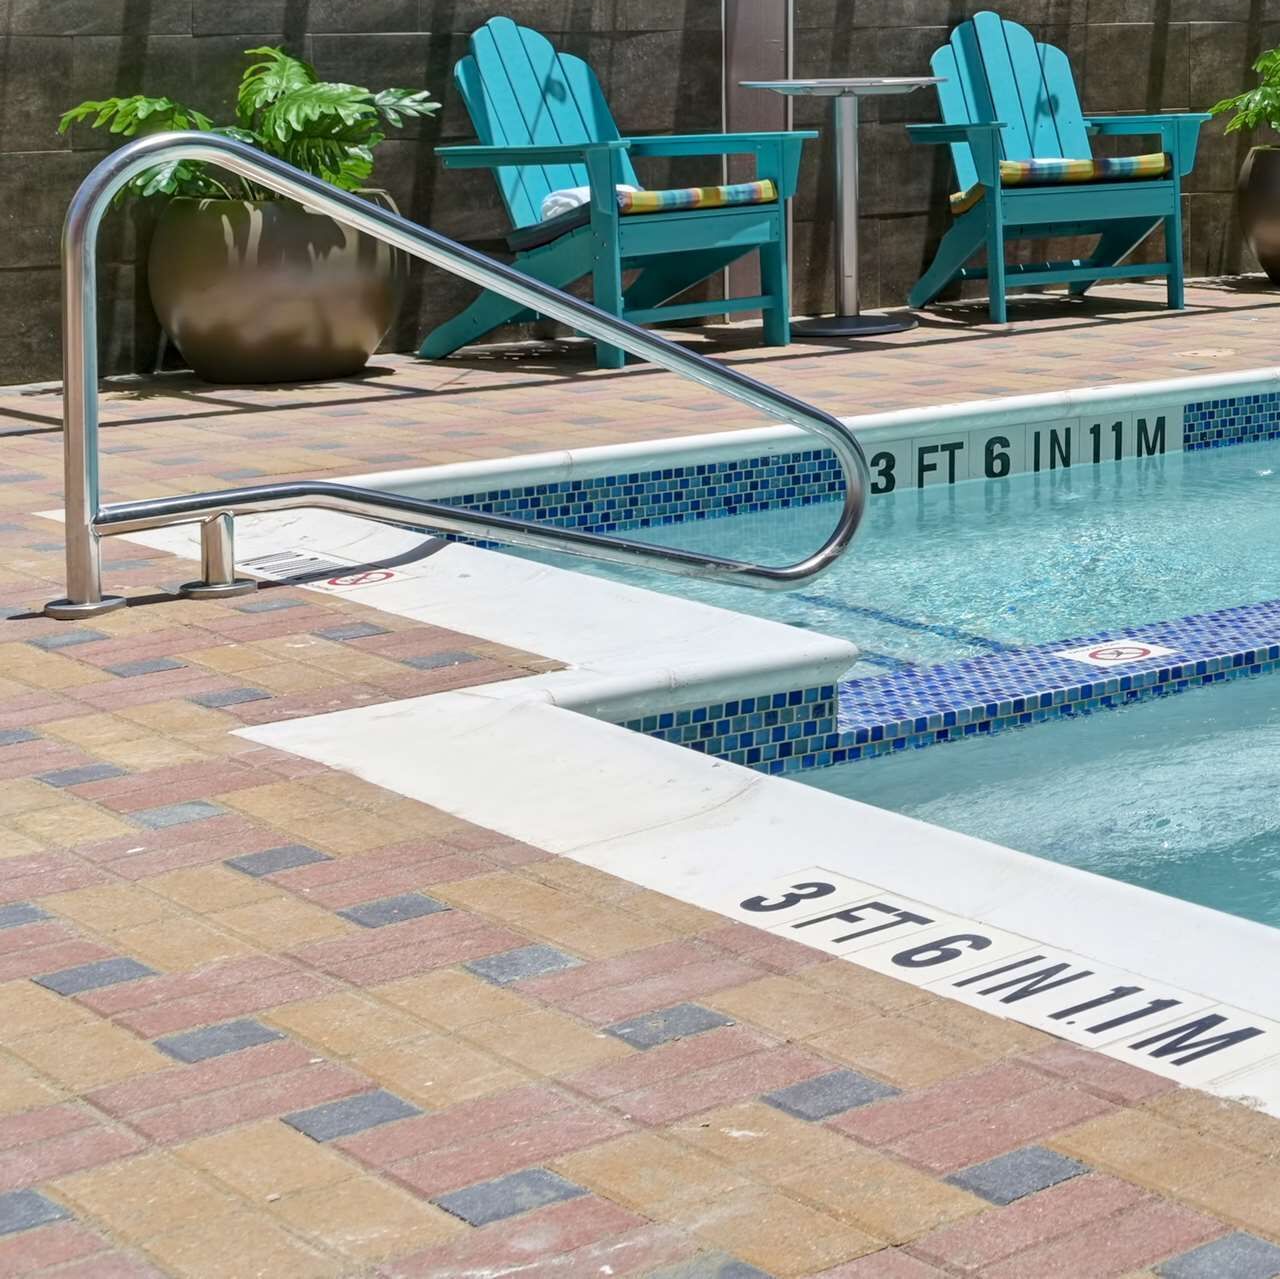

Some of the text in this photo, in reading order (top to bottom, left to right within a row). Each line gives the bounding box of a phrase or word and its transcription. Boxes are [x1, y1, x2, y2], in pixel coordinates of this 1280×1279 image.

[870, 451, 896, 495] 3
[917, 441, 964, 489] FT
[984, 436, 1010, 479] 6
[1033, 427, 1072, 473] IN
[1136, 415, 1166, 458] M
[739, 881, 1266, 1067] 3 FT 6 IN 1.1 M
